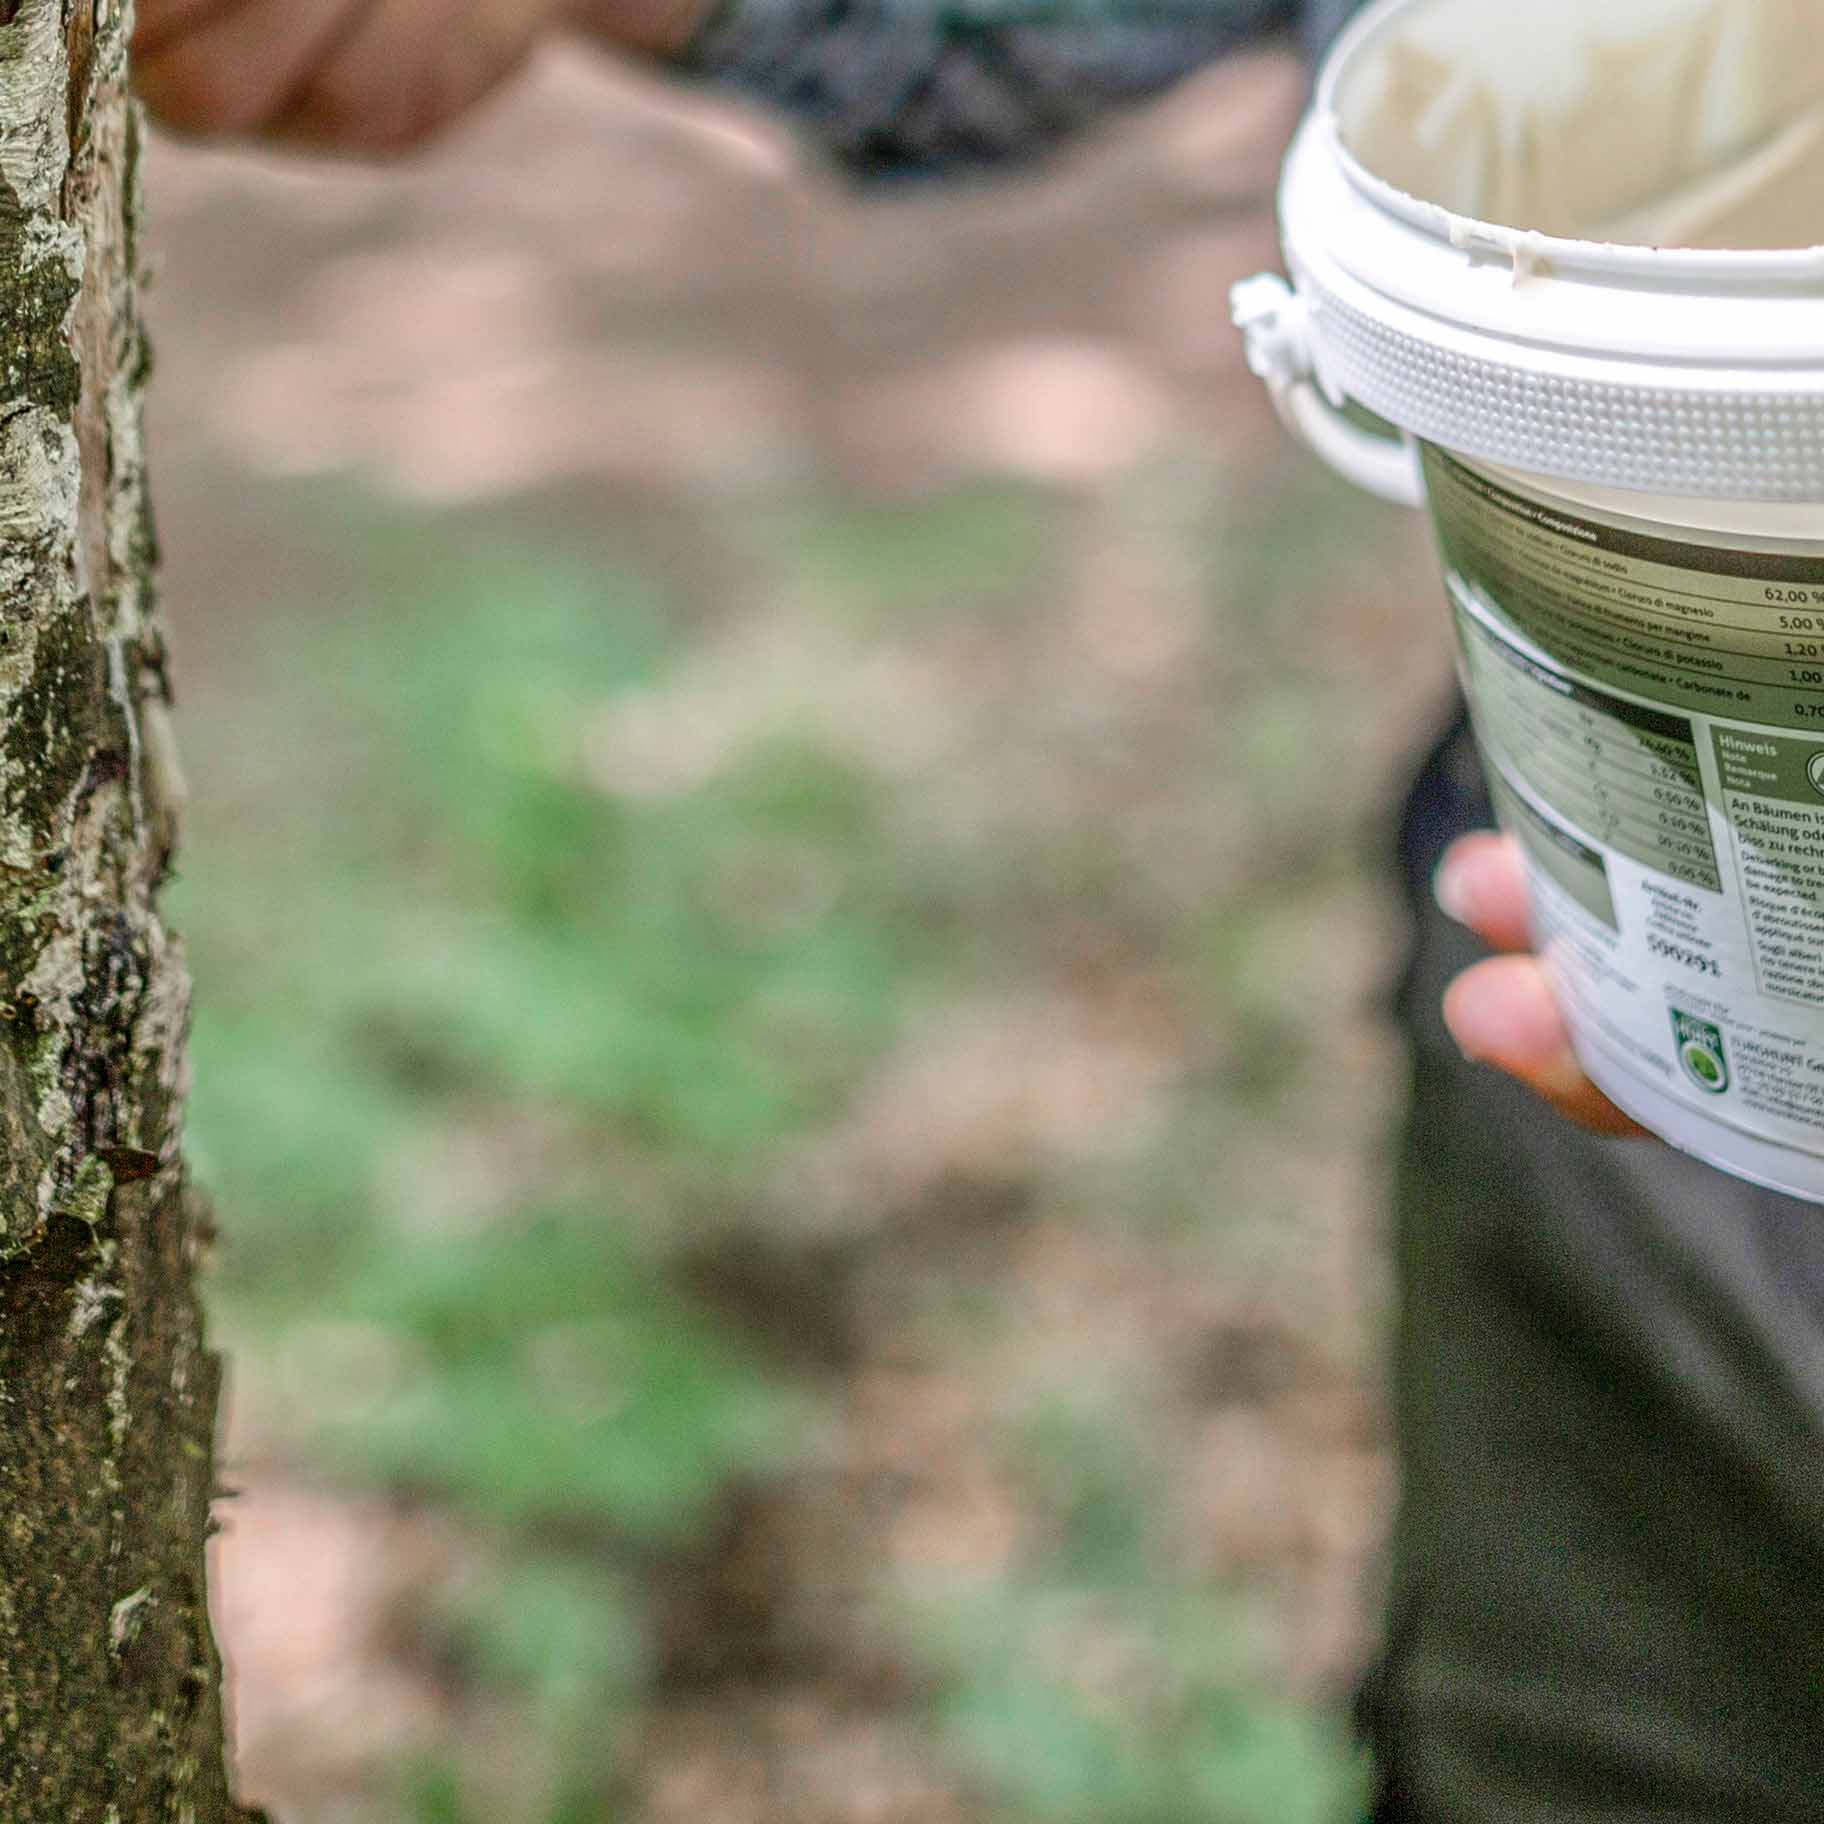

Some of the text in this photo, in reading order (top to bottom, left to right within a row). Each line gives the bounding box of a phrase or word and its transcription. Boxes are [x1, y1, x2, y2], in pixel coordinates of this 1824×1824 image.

[1764, 587, 1808, 604] 62,00
[1779, 615, 1813, 631] 5,00
[1788, 669, 1822, 683] 1,00
[1718, 734, 1777, 758] Hinweis
[1731, 797, 1750, 812] An
[1753, 801, 1812, 824] Bäumen
[1769, 840, 1784, 853] zu
[1802, 865, 1815, 873] or
